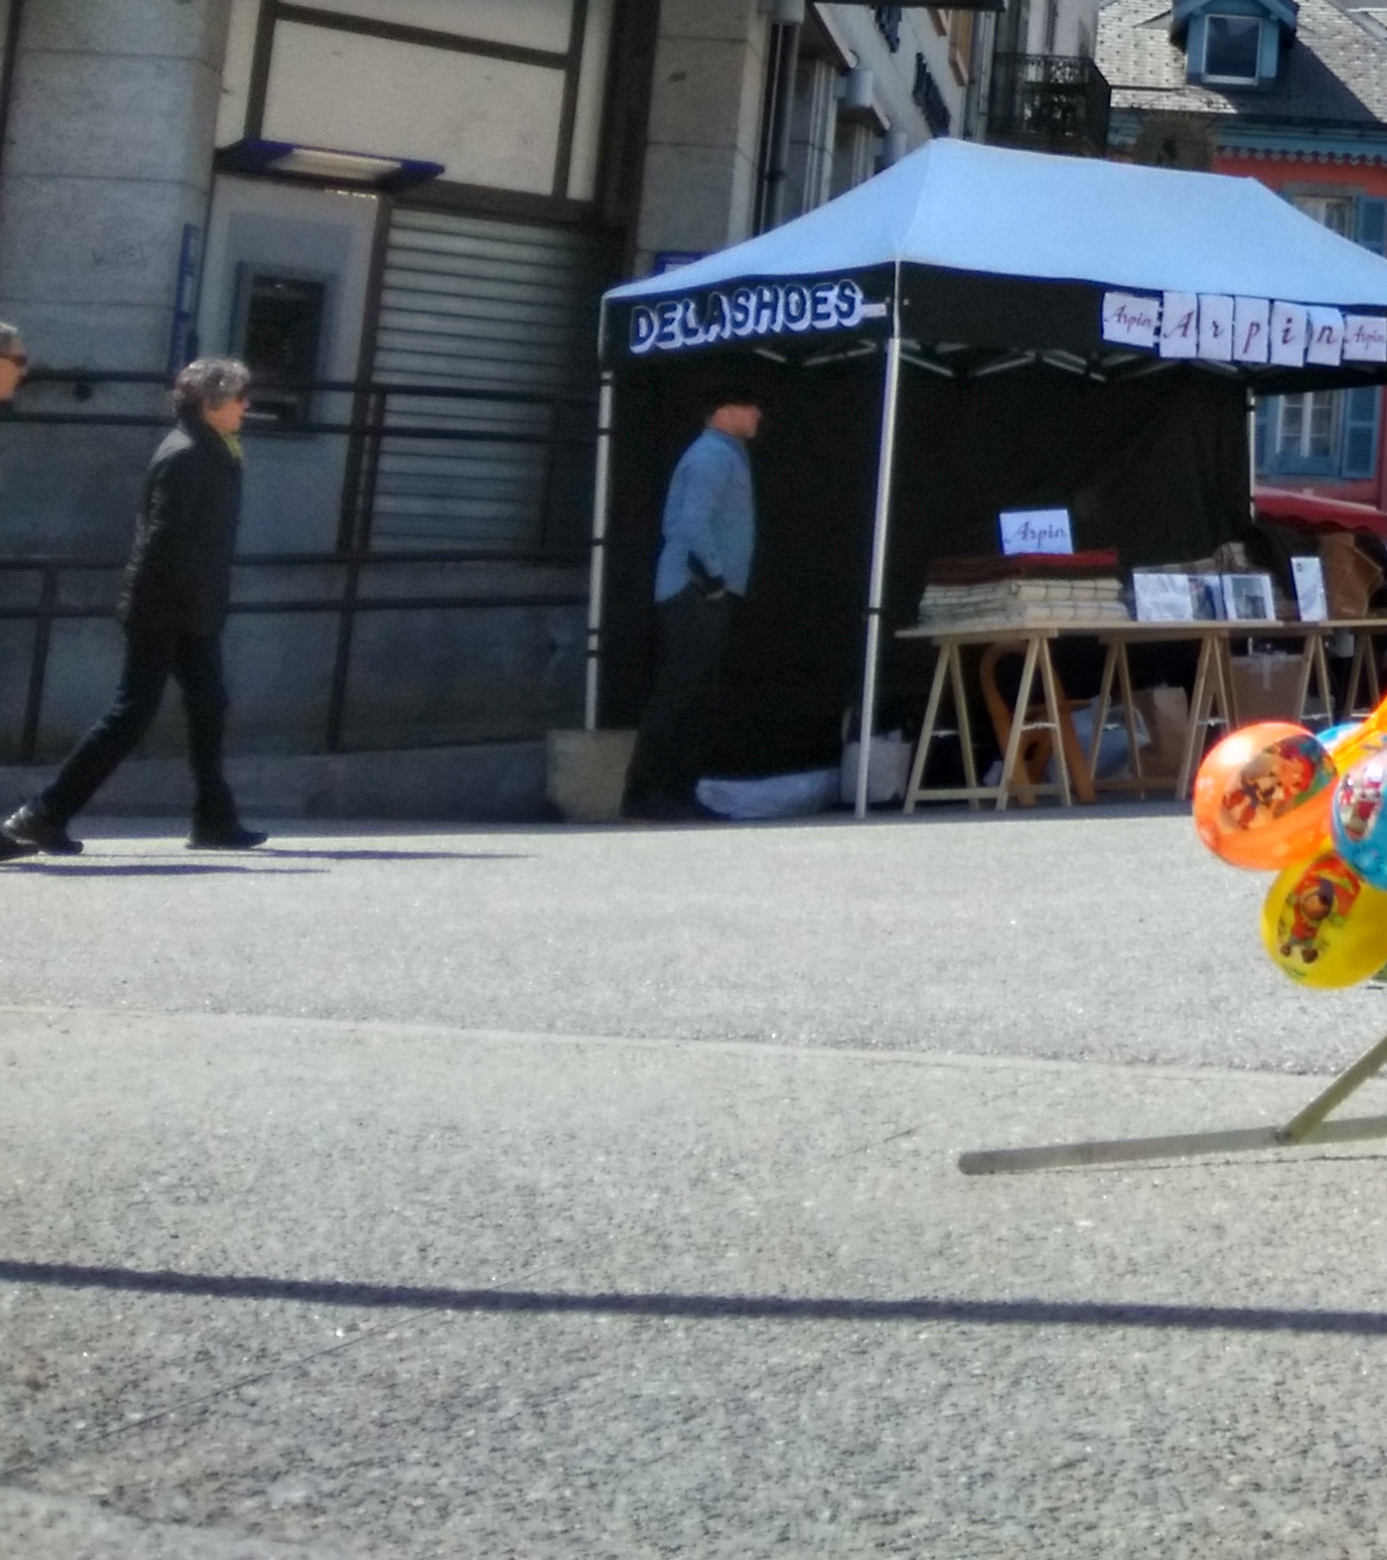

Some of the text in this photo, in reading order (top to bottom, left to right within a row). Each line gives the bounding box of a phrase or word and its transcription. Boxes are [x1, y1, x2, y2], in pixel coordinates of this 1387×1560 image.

[629, 278, 862, 354] DELASHOES
[1104, 304, 1152, 334] Arpin
[1006, 521, 1065, 549] Arpin
